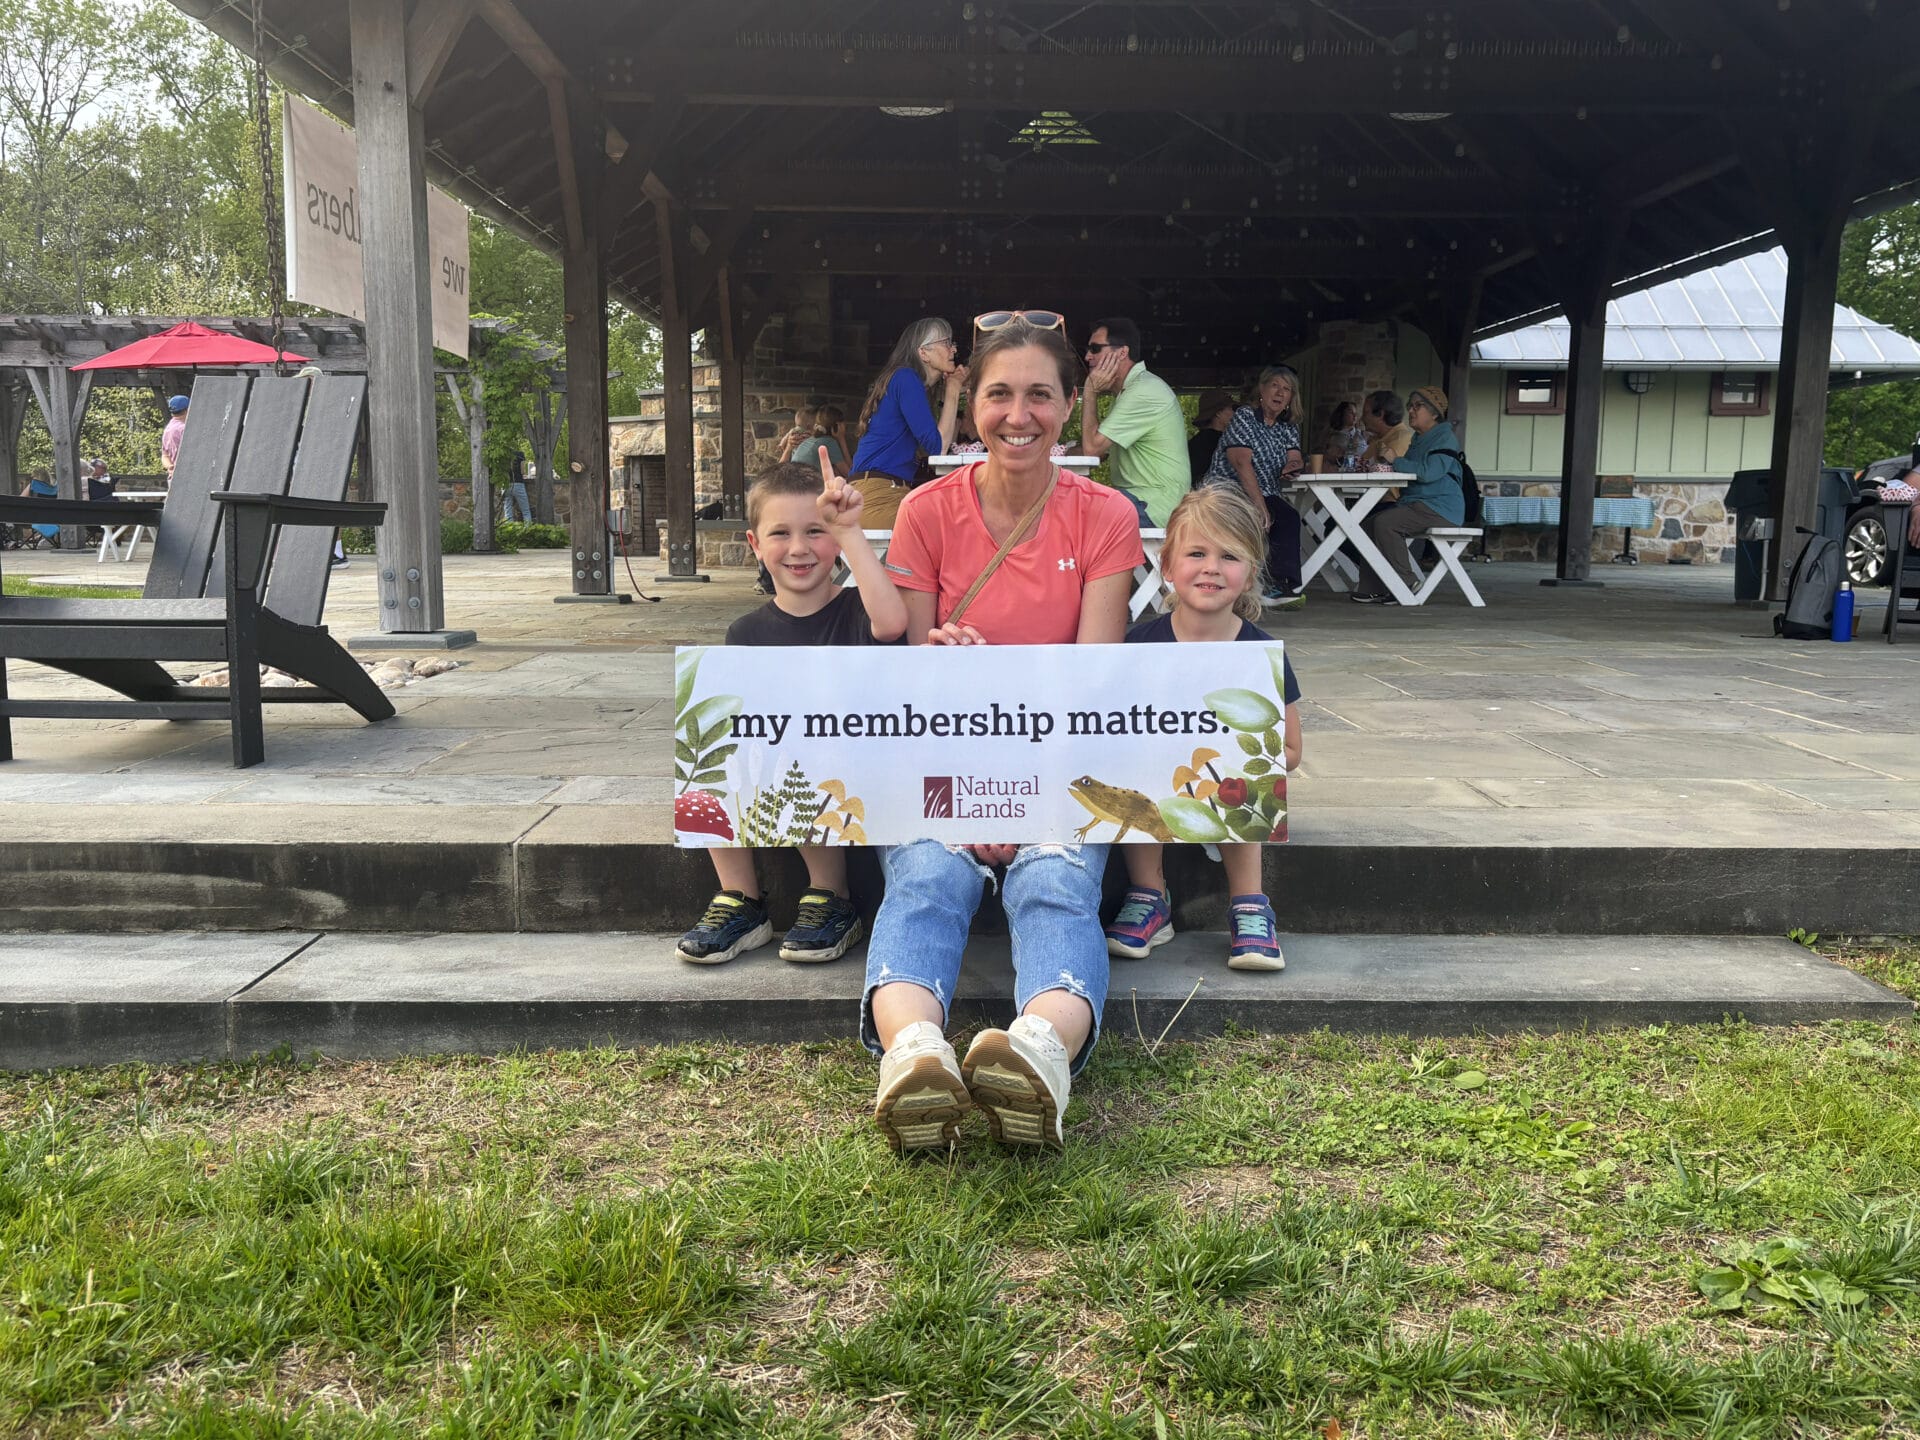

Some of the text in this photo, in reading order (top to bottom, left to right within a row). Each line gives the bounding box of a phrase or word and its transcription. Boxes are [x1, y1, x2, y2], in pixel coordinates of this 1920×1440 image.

[729, 703, 1230, 746] my membership matters.
[956, 775, 1040, 796] Natural
[956, 798, 1026, 819] Lands
